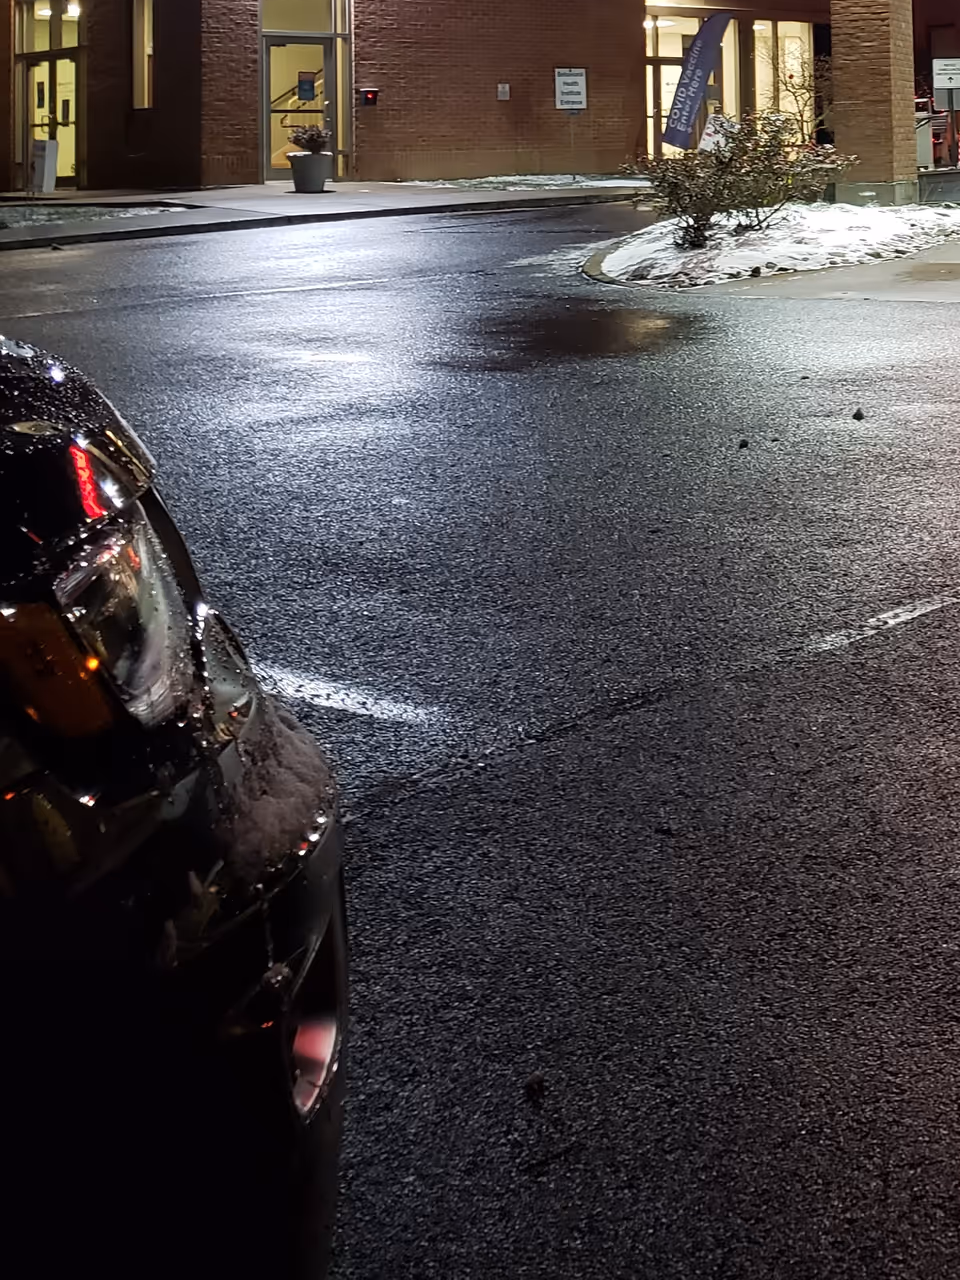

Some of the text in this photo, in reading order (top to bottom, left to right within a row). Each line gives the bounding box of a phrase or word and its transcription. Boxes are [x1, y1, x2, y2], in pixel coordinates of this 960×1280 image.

[669, 86, 688, 128] COVID
[681, 39, 703, 84] Vaccine
[677, 100, 692, 132] Enter
[687, 68, 703, 97] Here
